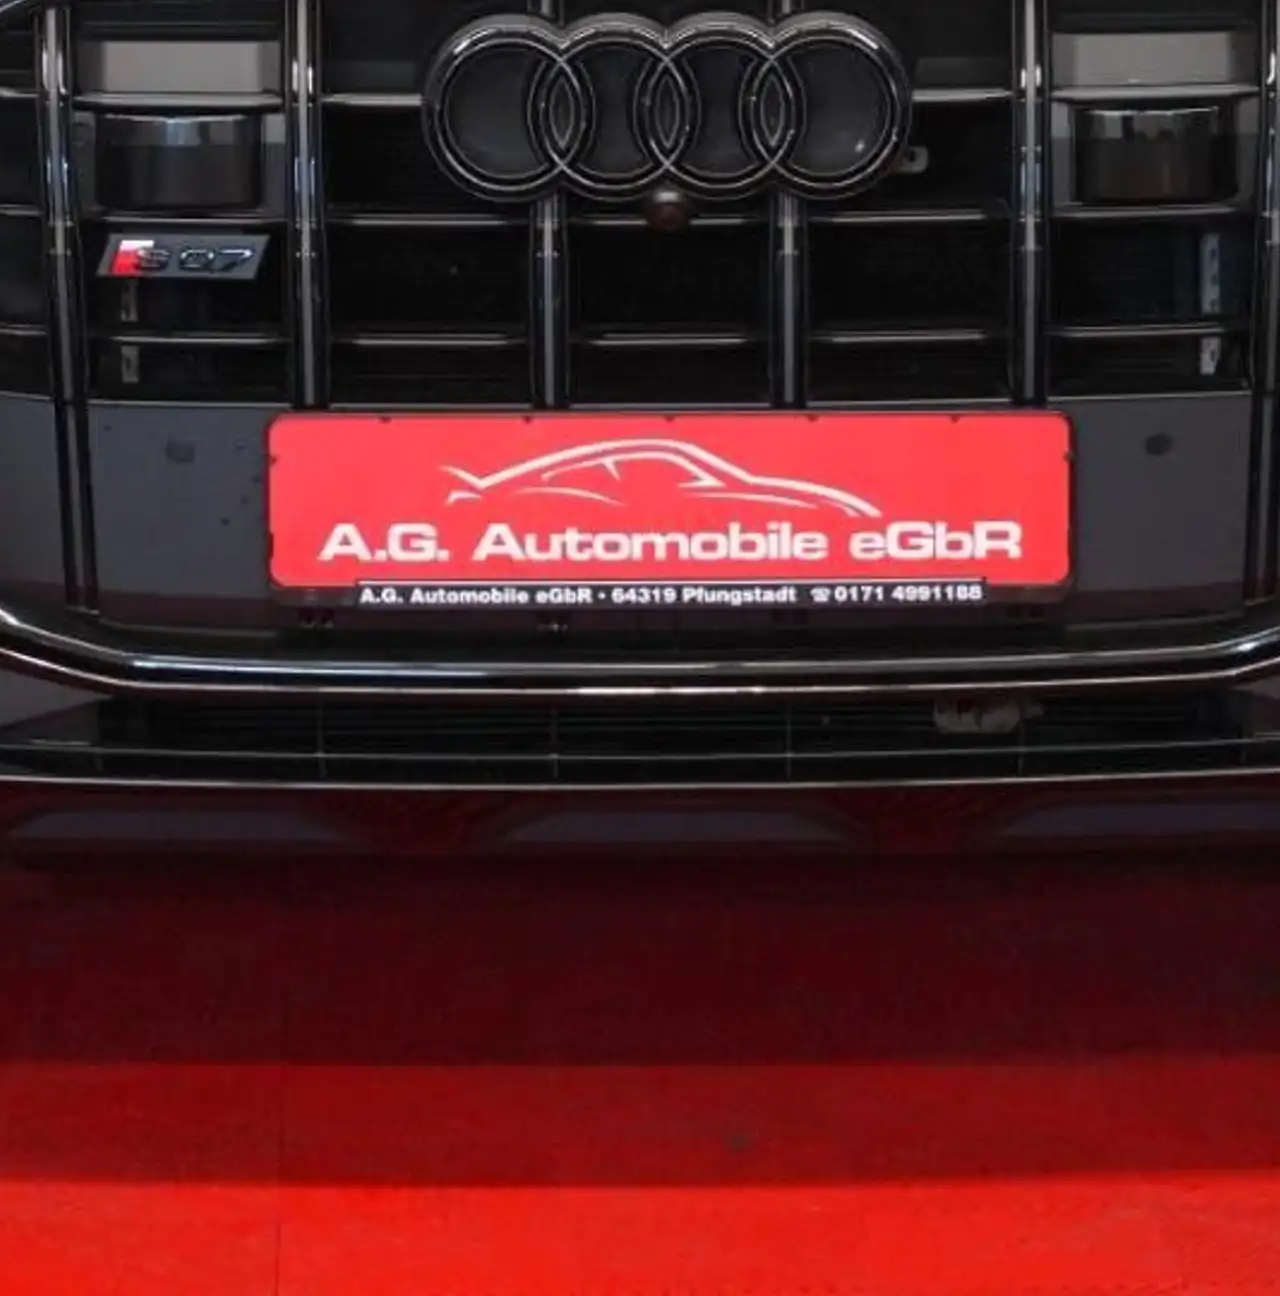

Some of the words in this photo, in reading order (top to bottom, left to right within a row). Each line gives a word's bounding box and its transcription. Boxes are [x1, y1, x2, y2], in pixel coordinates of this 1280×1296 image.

[318, 522, 451, 562] A.G.
[472, 521, 828, 562] Automobile
[848, 519, 1023, 561] eGbR
[359, 587, 404, 605] A.G.
[409, 586, 529, 605] Automobile
[534, 586, 593, 605] eGbR
[611, 586, 678, 605] 64319
[681, 585, 798, 607] Pfungstadt
[833, 585, 885, 603] 0171
